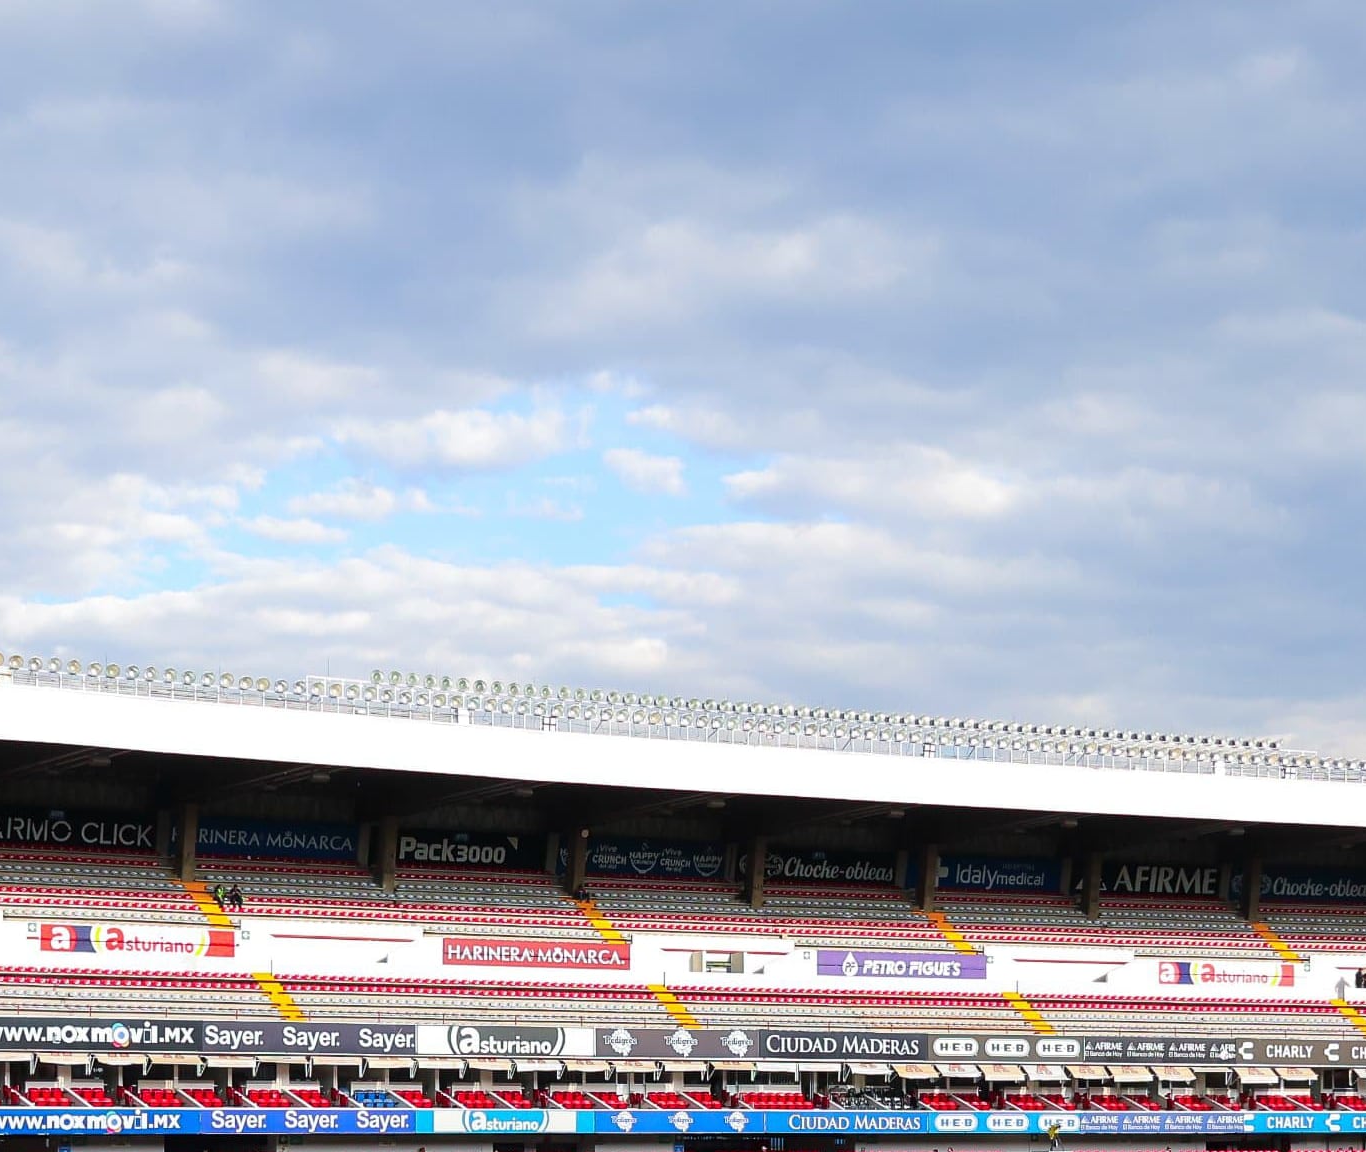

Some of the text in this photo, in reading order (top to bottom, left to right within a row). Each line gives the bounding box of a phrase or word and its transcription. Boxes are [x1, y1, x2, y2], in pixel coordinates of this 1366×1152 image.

[82, 822, 153, 846] CLICK
[399, 837, 506, 863] Pack3000
[592, 854, 626, 865] CRUNCH
[630, 852, 659, 861] HAPPY
[660, 857, 691, 869] CRUNCH
[1114, 865, 1216, 894] AFIRME
[448, 945, 529, 962] HARINERA
[863, 960, 961, 976] PETRO FIGUE'S
[459, 1027, 552, 1055] asturiano
[766, 1035, 919, 1055] CIUDAD MADERAS
[1095, 1042, 1123, 1051] AFIRME
[1135, 1043, 1164, 1051] AFIRME
[1177, 1043, 1206, 1051] AFIRME
[1267, 1046, 1313, 1058] CHARLY
[471, 1111, 539, 1131] asturiano
[789, 1115, 920, 1130] CIUDAD MADERAS
[1173, 1116, 1202, 1124] AFIRME
[1215, 1116, 1243, 1124] AFIRME
[1267, 1117, 1314, 1129] CHARLY
